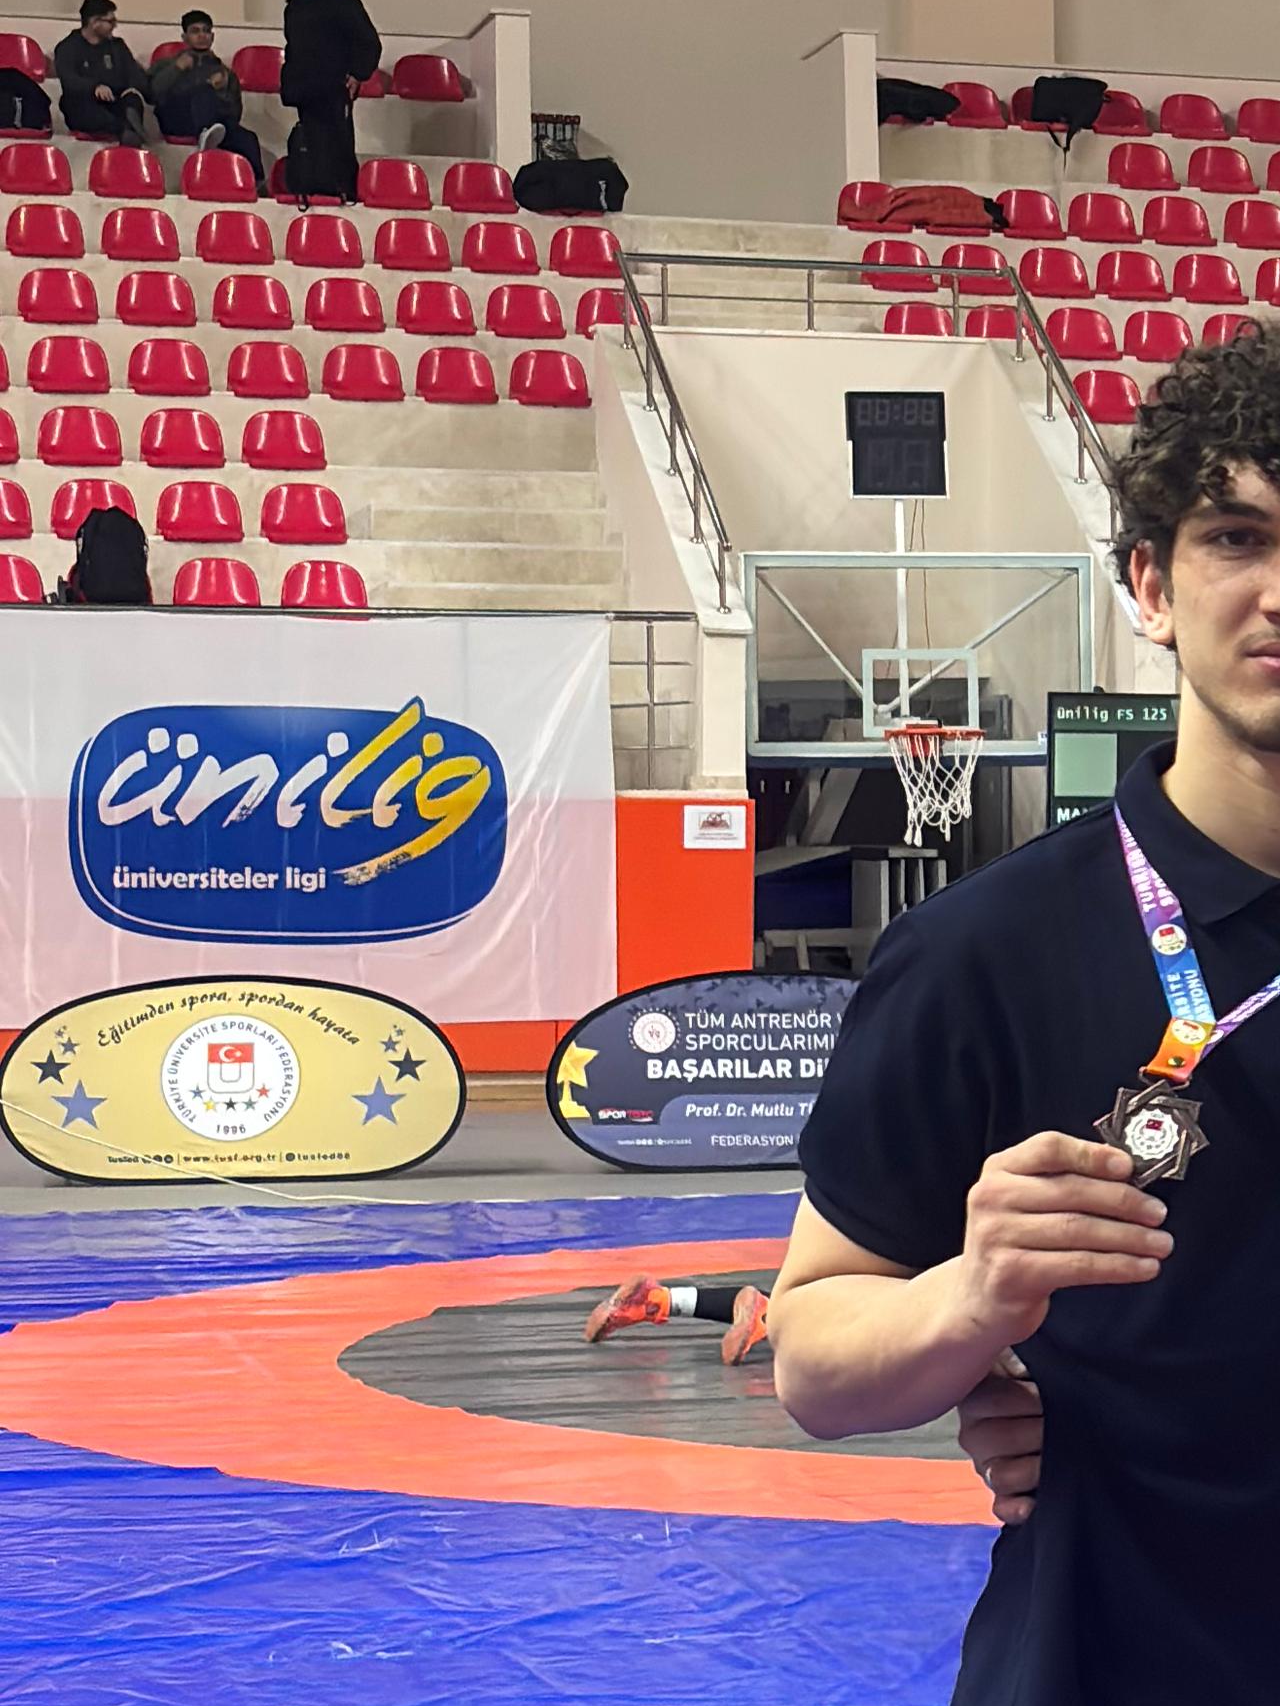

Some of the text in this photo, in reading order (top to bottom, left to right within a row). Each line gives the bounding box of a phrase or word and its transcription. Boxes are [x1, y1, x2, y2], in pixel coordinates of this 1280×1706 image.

[1117, 709, 1134, 720] FS
[1142, 707, 1167, 721] 125
[113, 865, 327, 893] üniversiteler ligi
[238, 991, 305, 1015] spordan
[308, 1006, 361, 1046] hayata
[684, 1009, 725, 1029] TÜM
[731, 1009, 832, 1029] ANTRENÖR
[685, 1034, 839, 1051] SPORCULARIMI
[221, 1020, 278, 1045] SPORLARI
[263, 1044, 293, 1122] FEDERASYONU
[647, 1058, 793, 1083] BAŞARILAR
[685, 1103, 722, 1117] Prof.
[726, 1103, 747, 1117] Dr.
[751, 1103, 794, 1117] Mutlu
[711, 1135, 794, 1147] FEDERASYON
